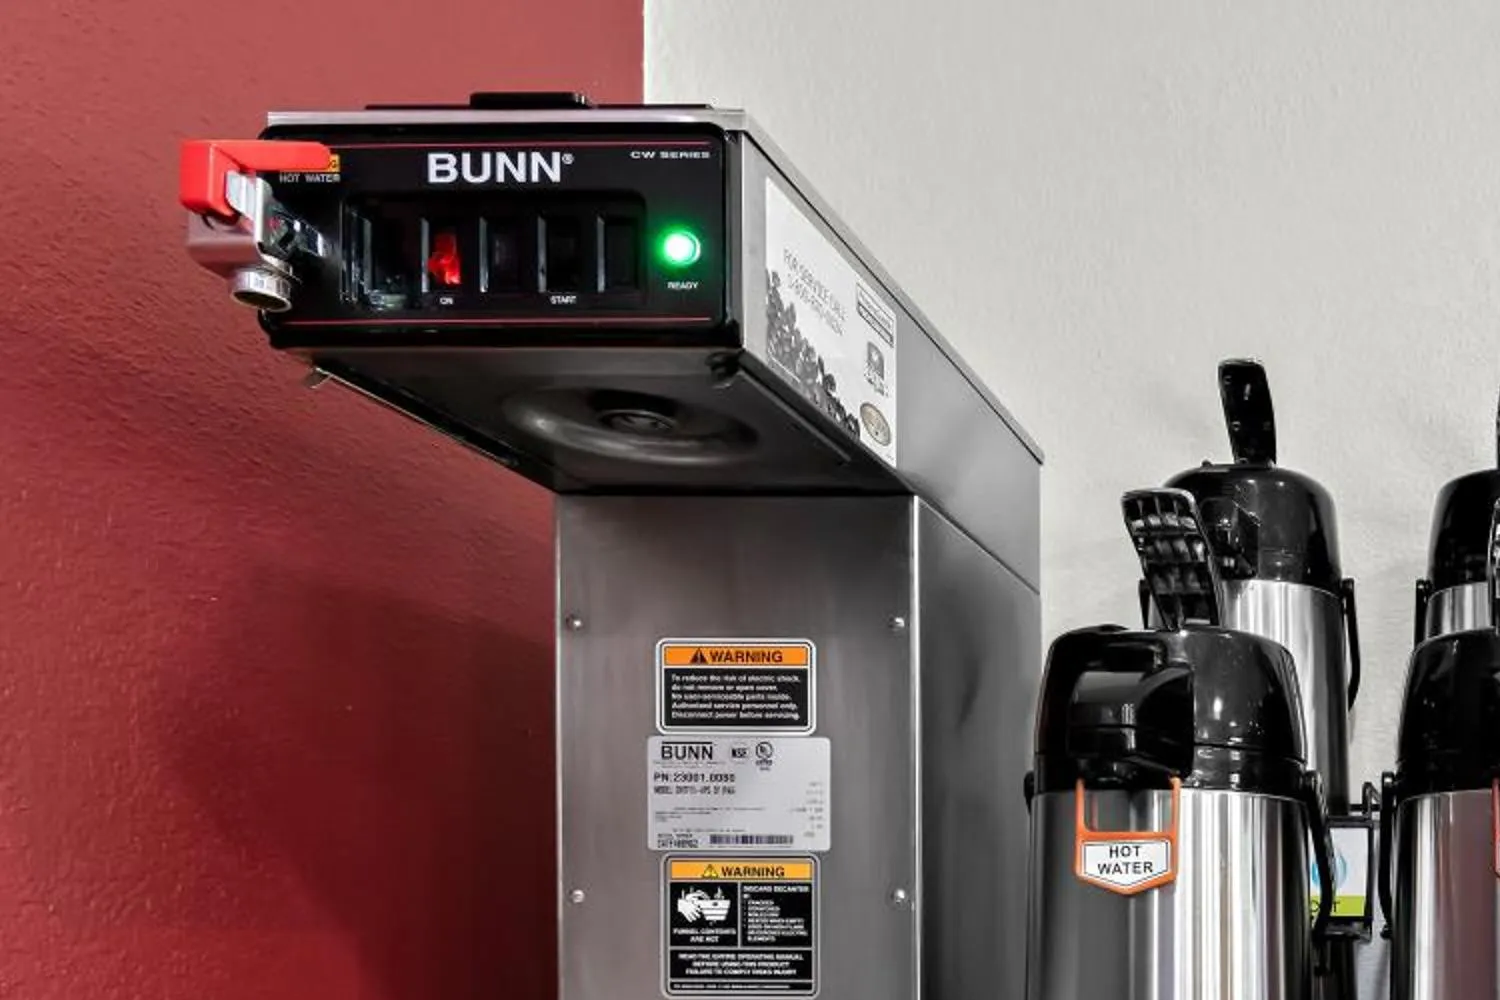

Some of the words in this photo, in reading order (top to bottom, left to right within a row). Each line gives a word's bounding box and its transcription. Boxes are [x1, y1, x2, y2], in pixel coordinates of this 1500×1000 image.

[630, 151, 656, 159] CW
[659, 151, 710, 159] SERIES
[667, 281, 699, 290] READY
[709, 650, 783, 663] WARNING
[661, 745, 713, 760] BUNN
[1109, 845, 1141, 858] HOT
[721, 865, 785, 877] WARNING
[1097, 861, 1153, 874] WATER
